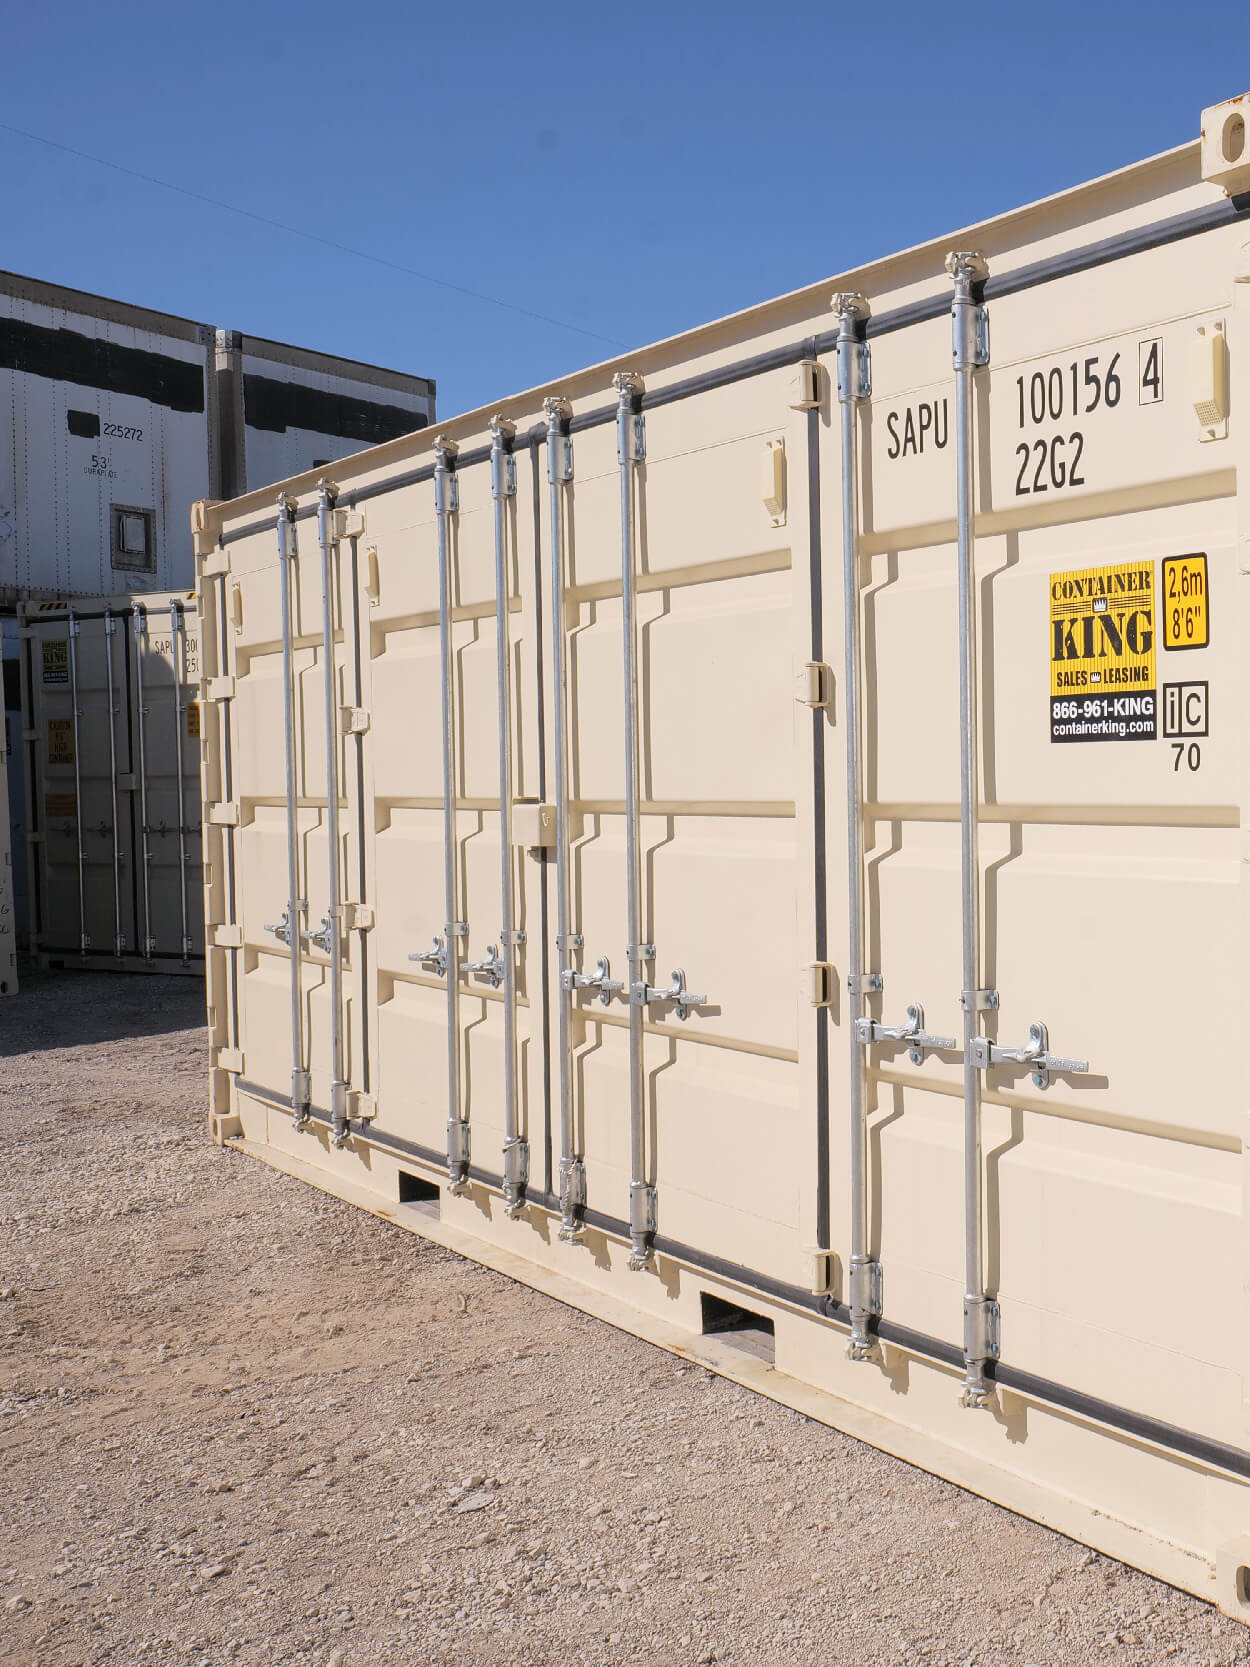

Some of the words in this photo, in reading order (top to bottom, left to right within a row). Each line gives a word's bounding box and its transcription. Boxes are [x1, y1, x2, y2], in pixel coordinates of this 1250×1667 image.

[887, 398, 949, 459] SAPU
[1015, 352, 1122, 429] 100156
[1141, 342, 1161, 399] 4
[103, 422, 143, 442] 225272
[1015, 431, 1085, 496] 22G2
[1052, 570, 1151, 600] CONTAINER
[1168, 565, 1203, 604] 2,6m
[1052, 609, 1153, 661] KING
[1172, 606, 1201, 640] 8'6"
[1056, 670, 1088, 687] SALES
[1103, 665, 1149, 684] LEASING
[1052, 697, 1155, 719] 866-961-KING
[1053, 718, 1155, 737] containerking.com
[1170, 742, 1201, 772] 70
